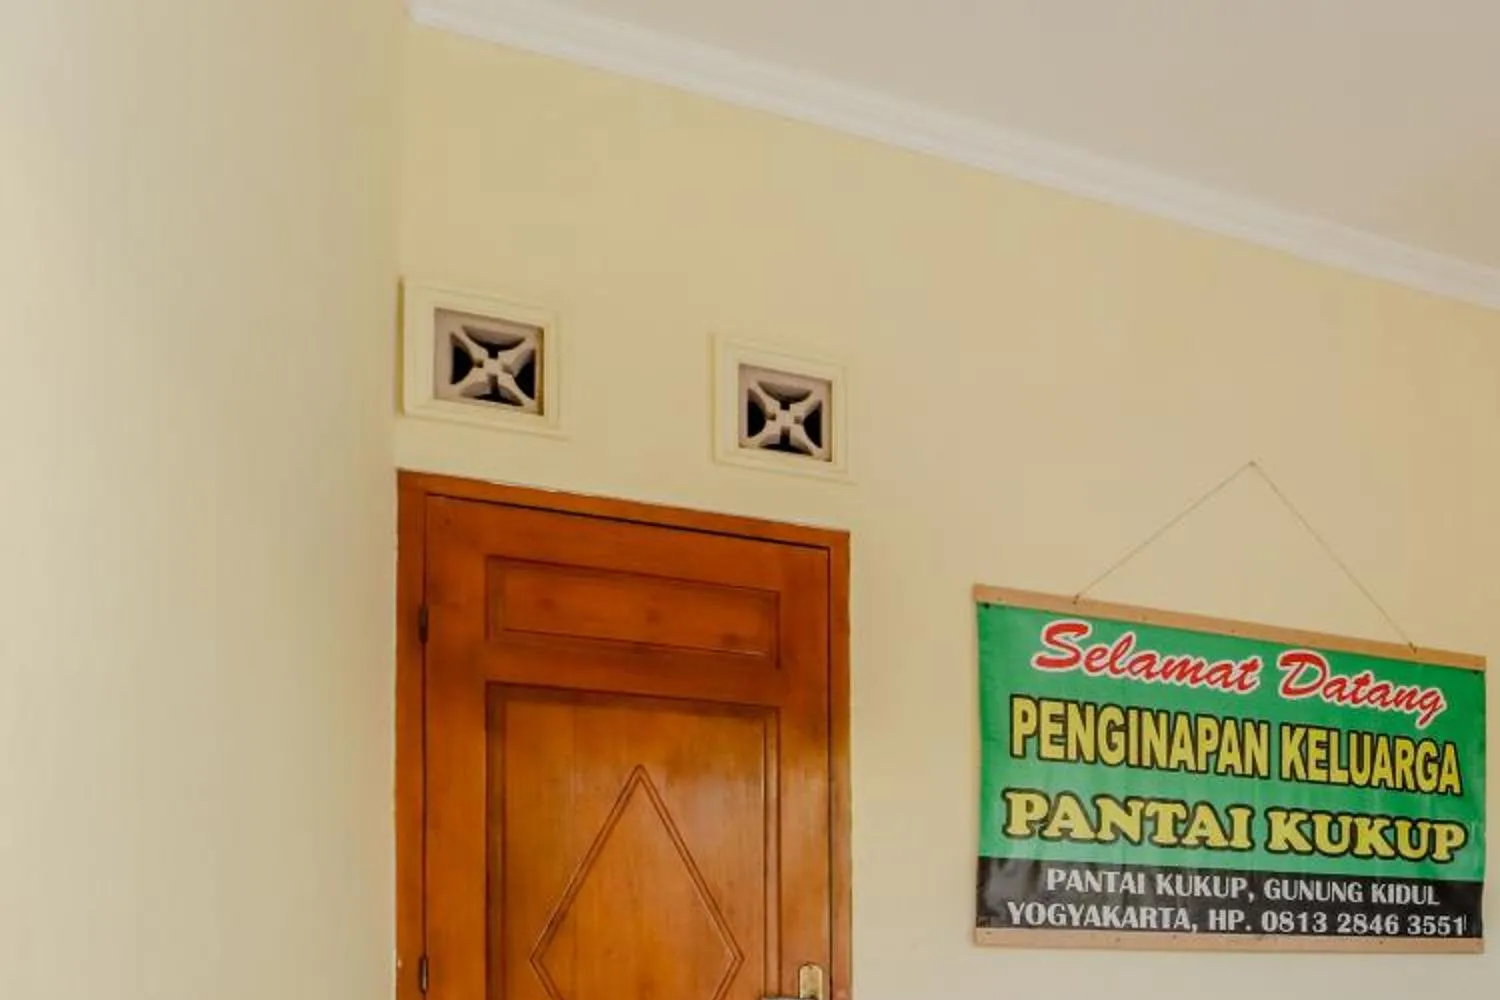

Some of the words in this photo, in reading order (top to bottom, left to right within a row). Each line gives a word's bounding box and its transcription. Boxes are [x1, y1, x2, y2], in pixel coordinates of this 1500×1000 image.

[1031, 618, 1263, 695] Selamat
[1277, 650, 1447, 729] Datang
[1010, 695, 1270, 779] PENGINAPAN
[1279, 722, 1463, 796] KELUARGA
[1001, 788, 1255, 852] PANTAI
[1264, 807, 1468, 863] KUKUP
[1007, 901, 1199, 933] YOGYAKARTA,
[1208, 909, 1252, 931] HP.
[1261, 910, 1328, 933] 0813
[1337, 914, 1400, 935] 2846
[1407, 915, 1464, 936] 3551
[1047, 868, 1145, 894] PANTAI
[1156, 873, 1255, 902] KUKUP,
[1263, 878, 1364, 903] GUNUNG
[1371, 883, 1440, 905] KIDUL
